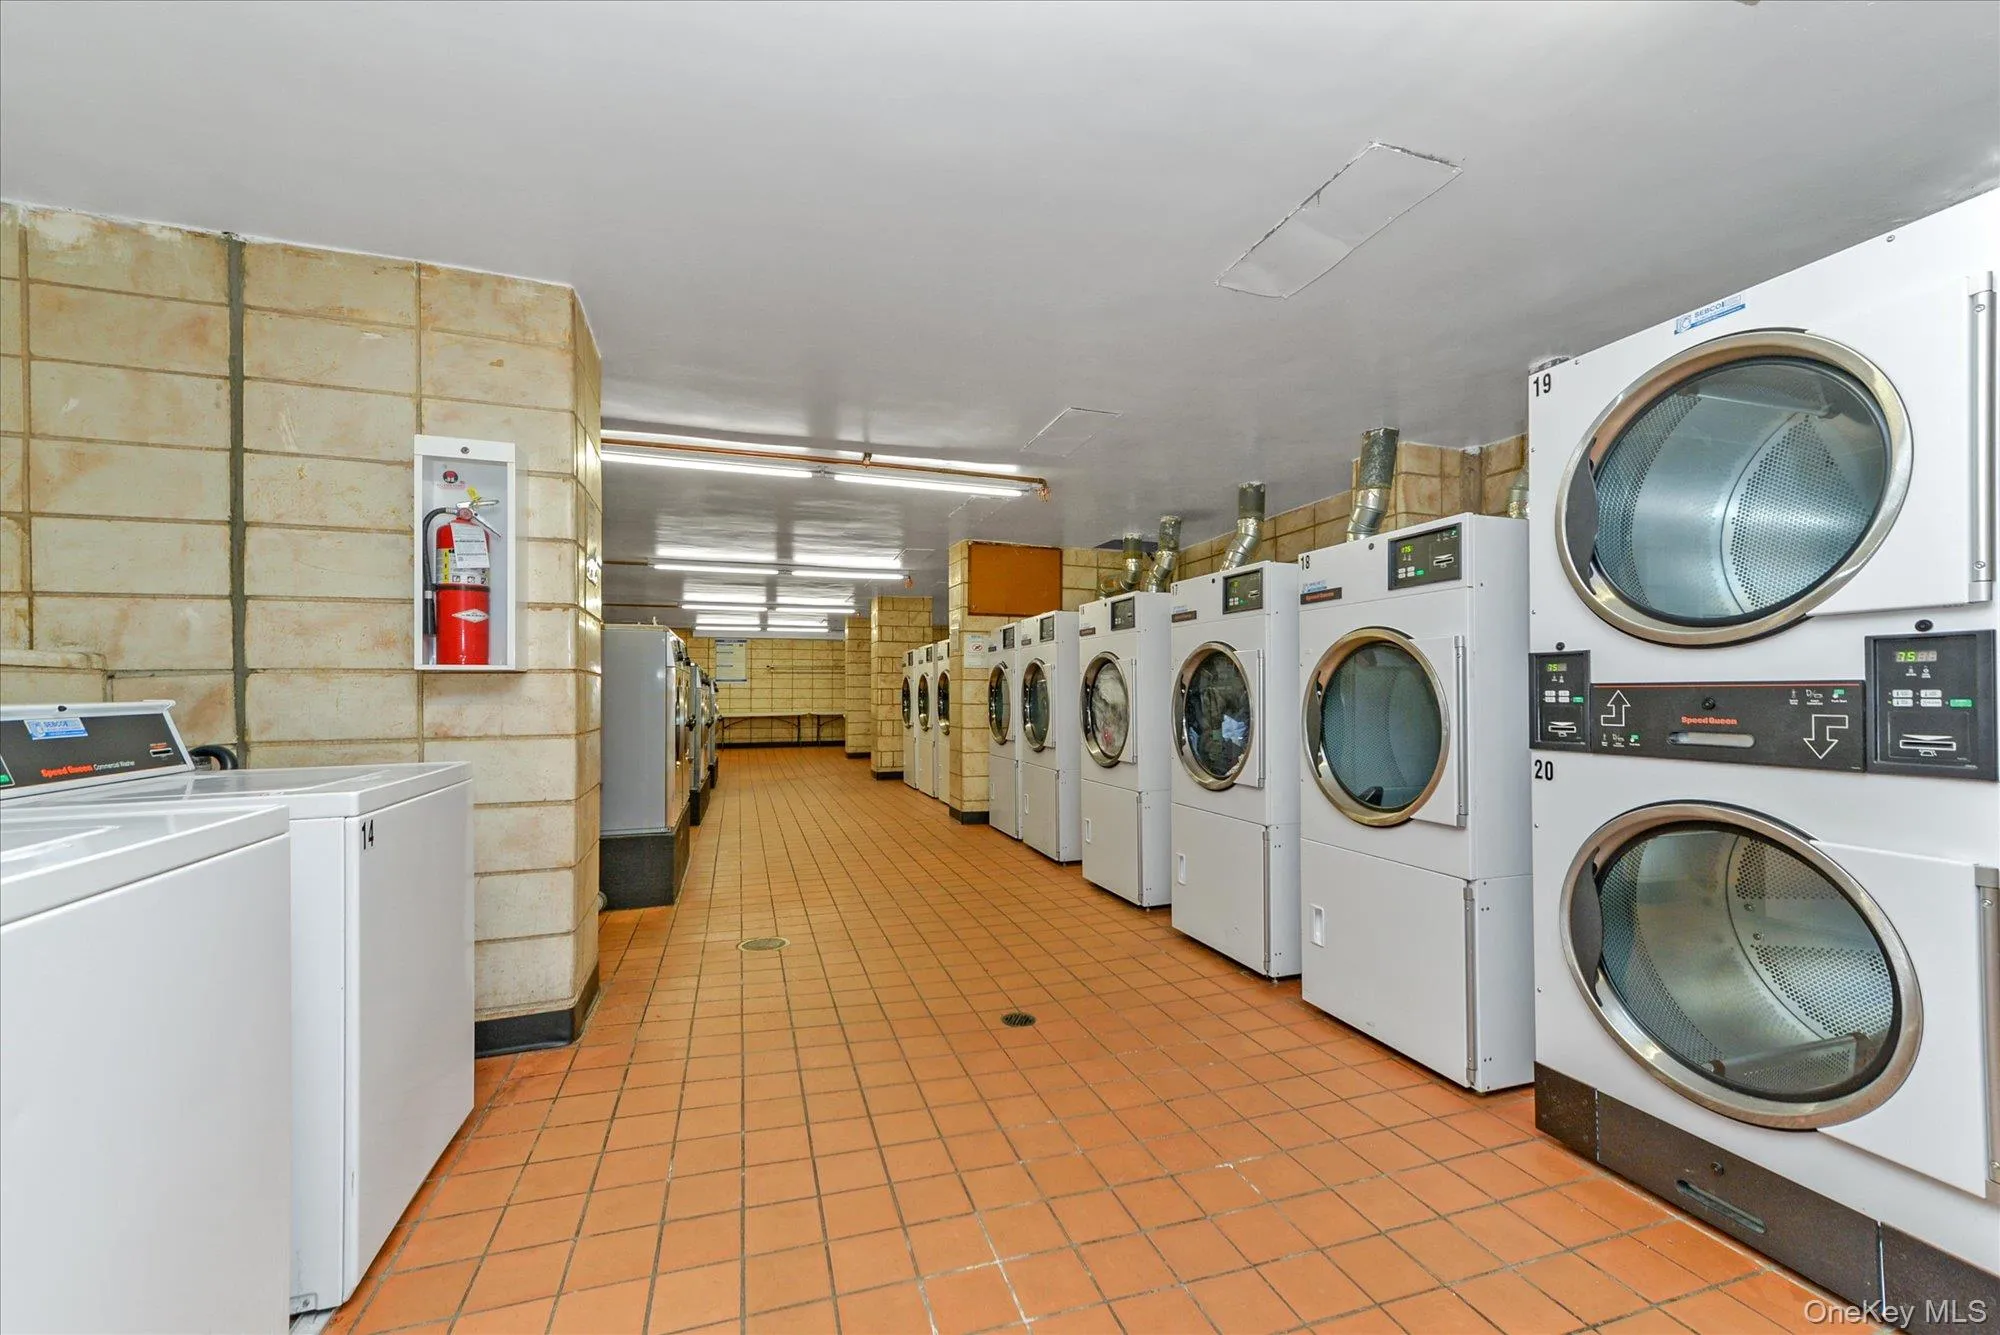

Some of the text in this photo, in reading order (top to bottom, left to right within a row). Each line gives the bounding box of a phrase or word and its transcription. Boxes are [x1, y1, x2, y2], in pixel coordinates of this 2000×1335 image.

[1533, 373, 1551, 397] 19
[1300, 555, 1311, 570] 18
[1681, 716, 1738, 725] Speed Queen
[41, 766, 67, 778] Speed
[68, 764, 93, 775] Queen
[93, 762, 119, 771] Commercial
[1534, 759, 1554, 781] 20
[362, 819, 374, 850] 14
